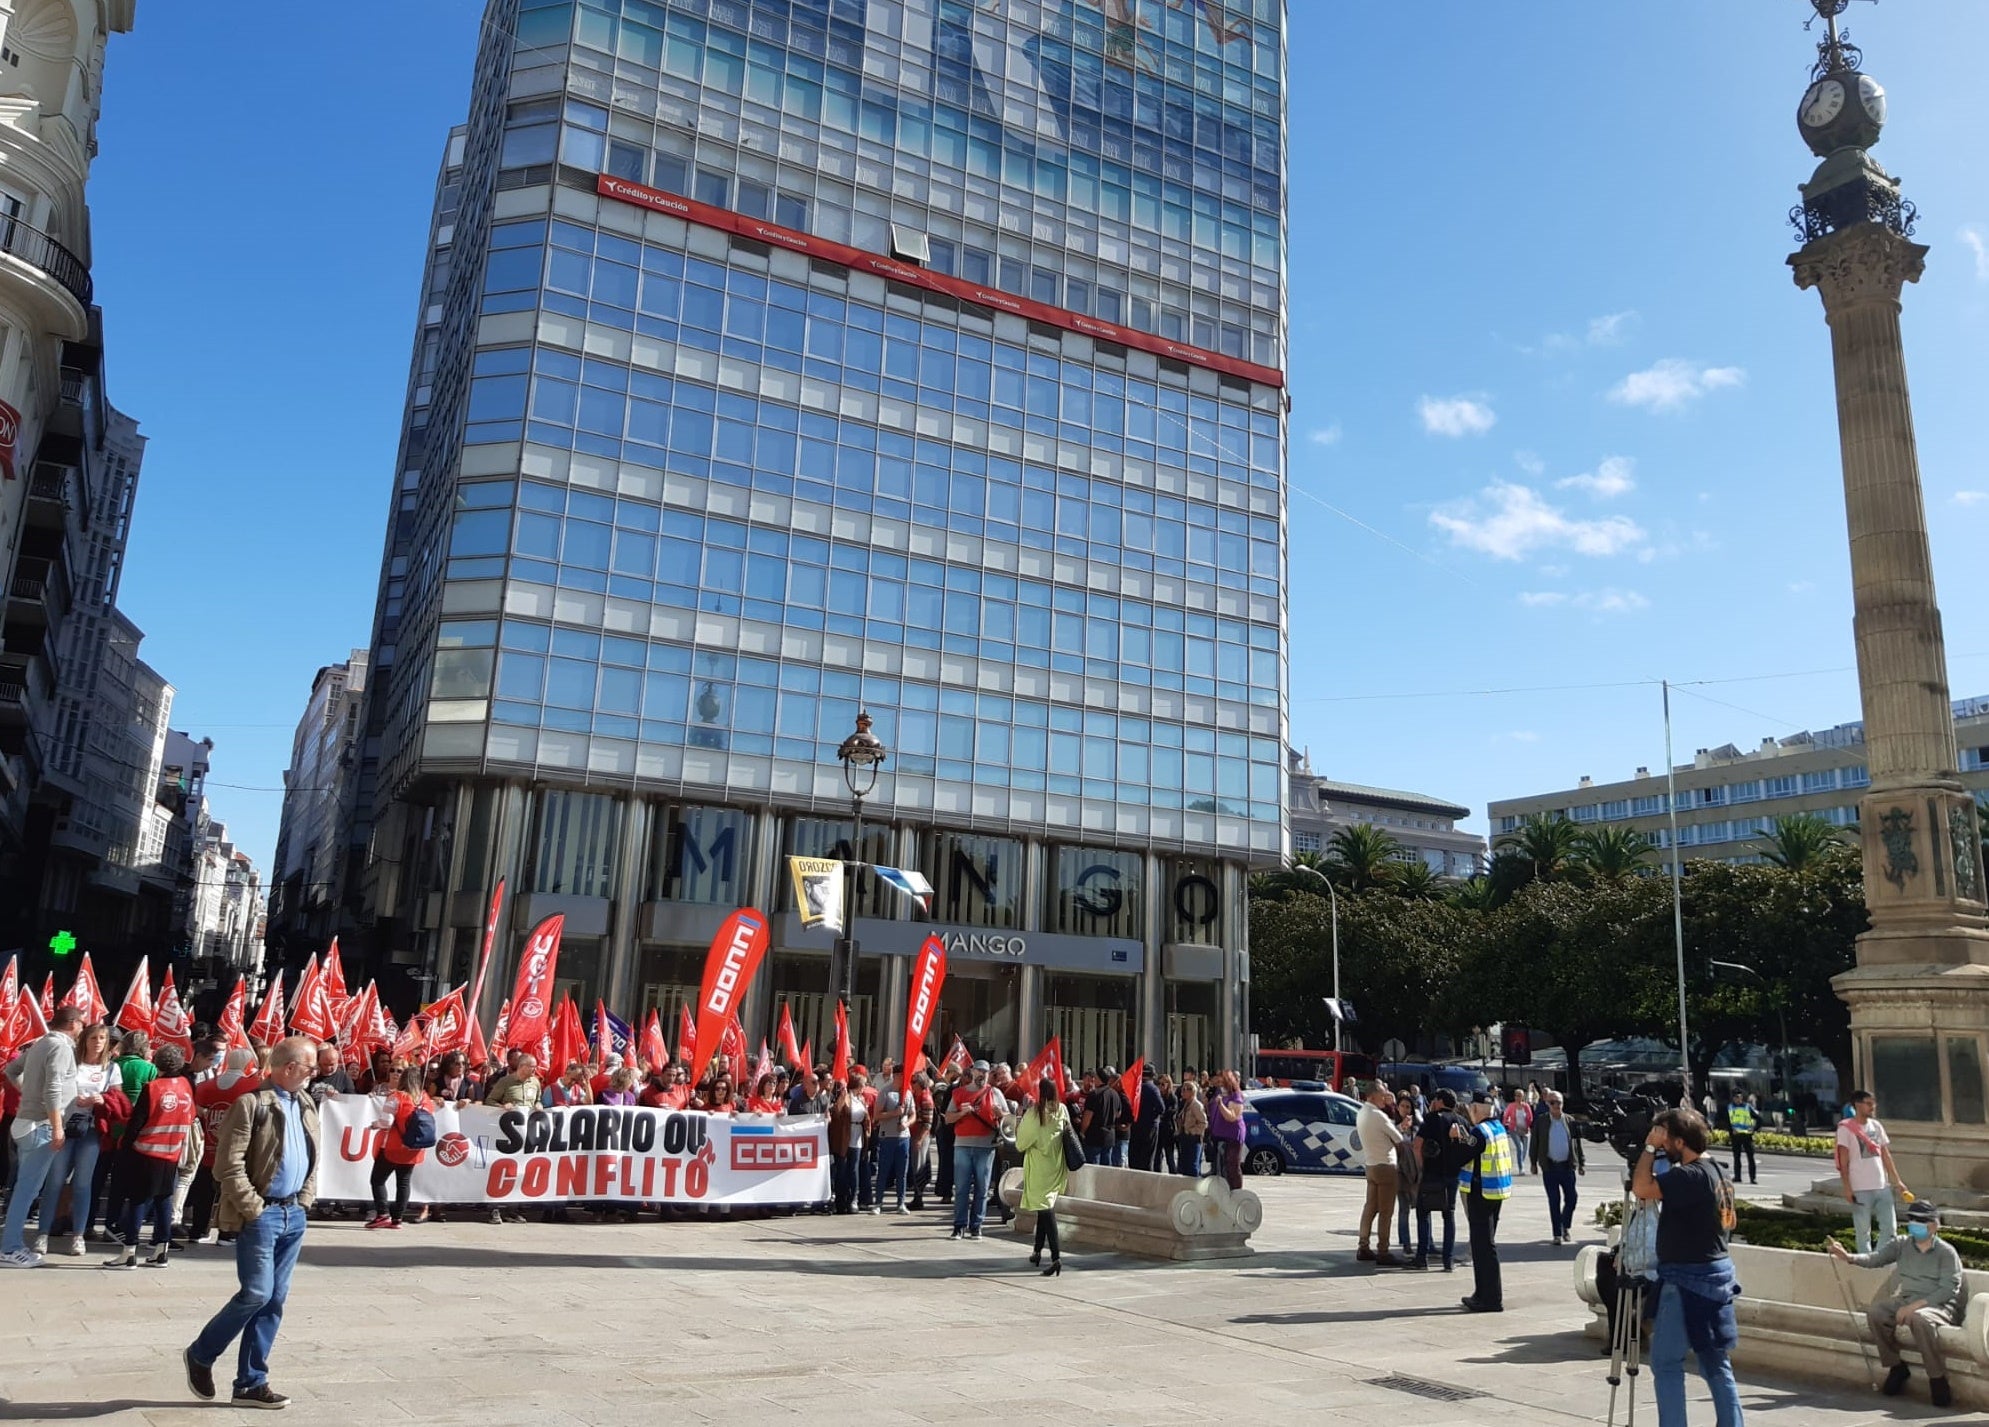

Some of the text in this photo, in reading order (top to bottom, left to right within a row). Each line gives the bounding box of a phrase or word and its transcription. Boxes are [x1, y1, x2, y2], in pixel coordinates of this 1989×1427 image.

[617, 185, 689, 212] Crédito y Caución
[707, 924, 755, 1014] CCOO
[495, 1108, 708, 1156] SALARIO OU
[736, 1142, 813, 1165] CCOO
[486, 1154, 710, 1198] CONFLITO
